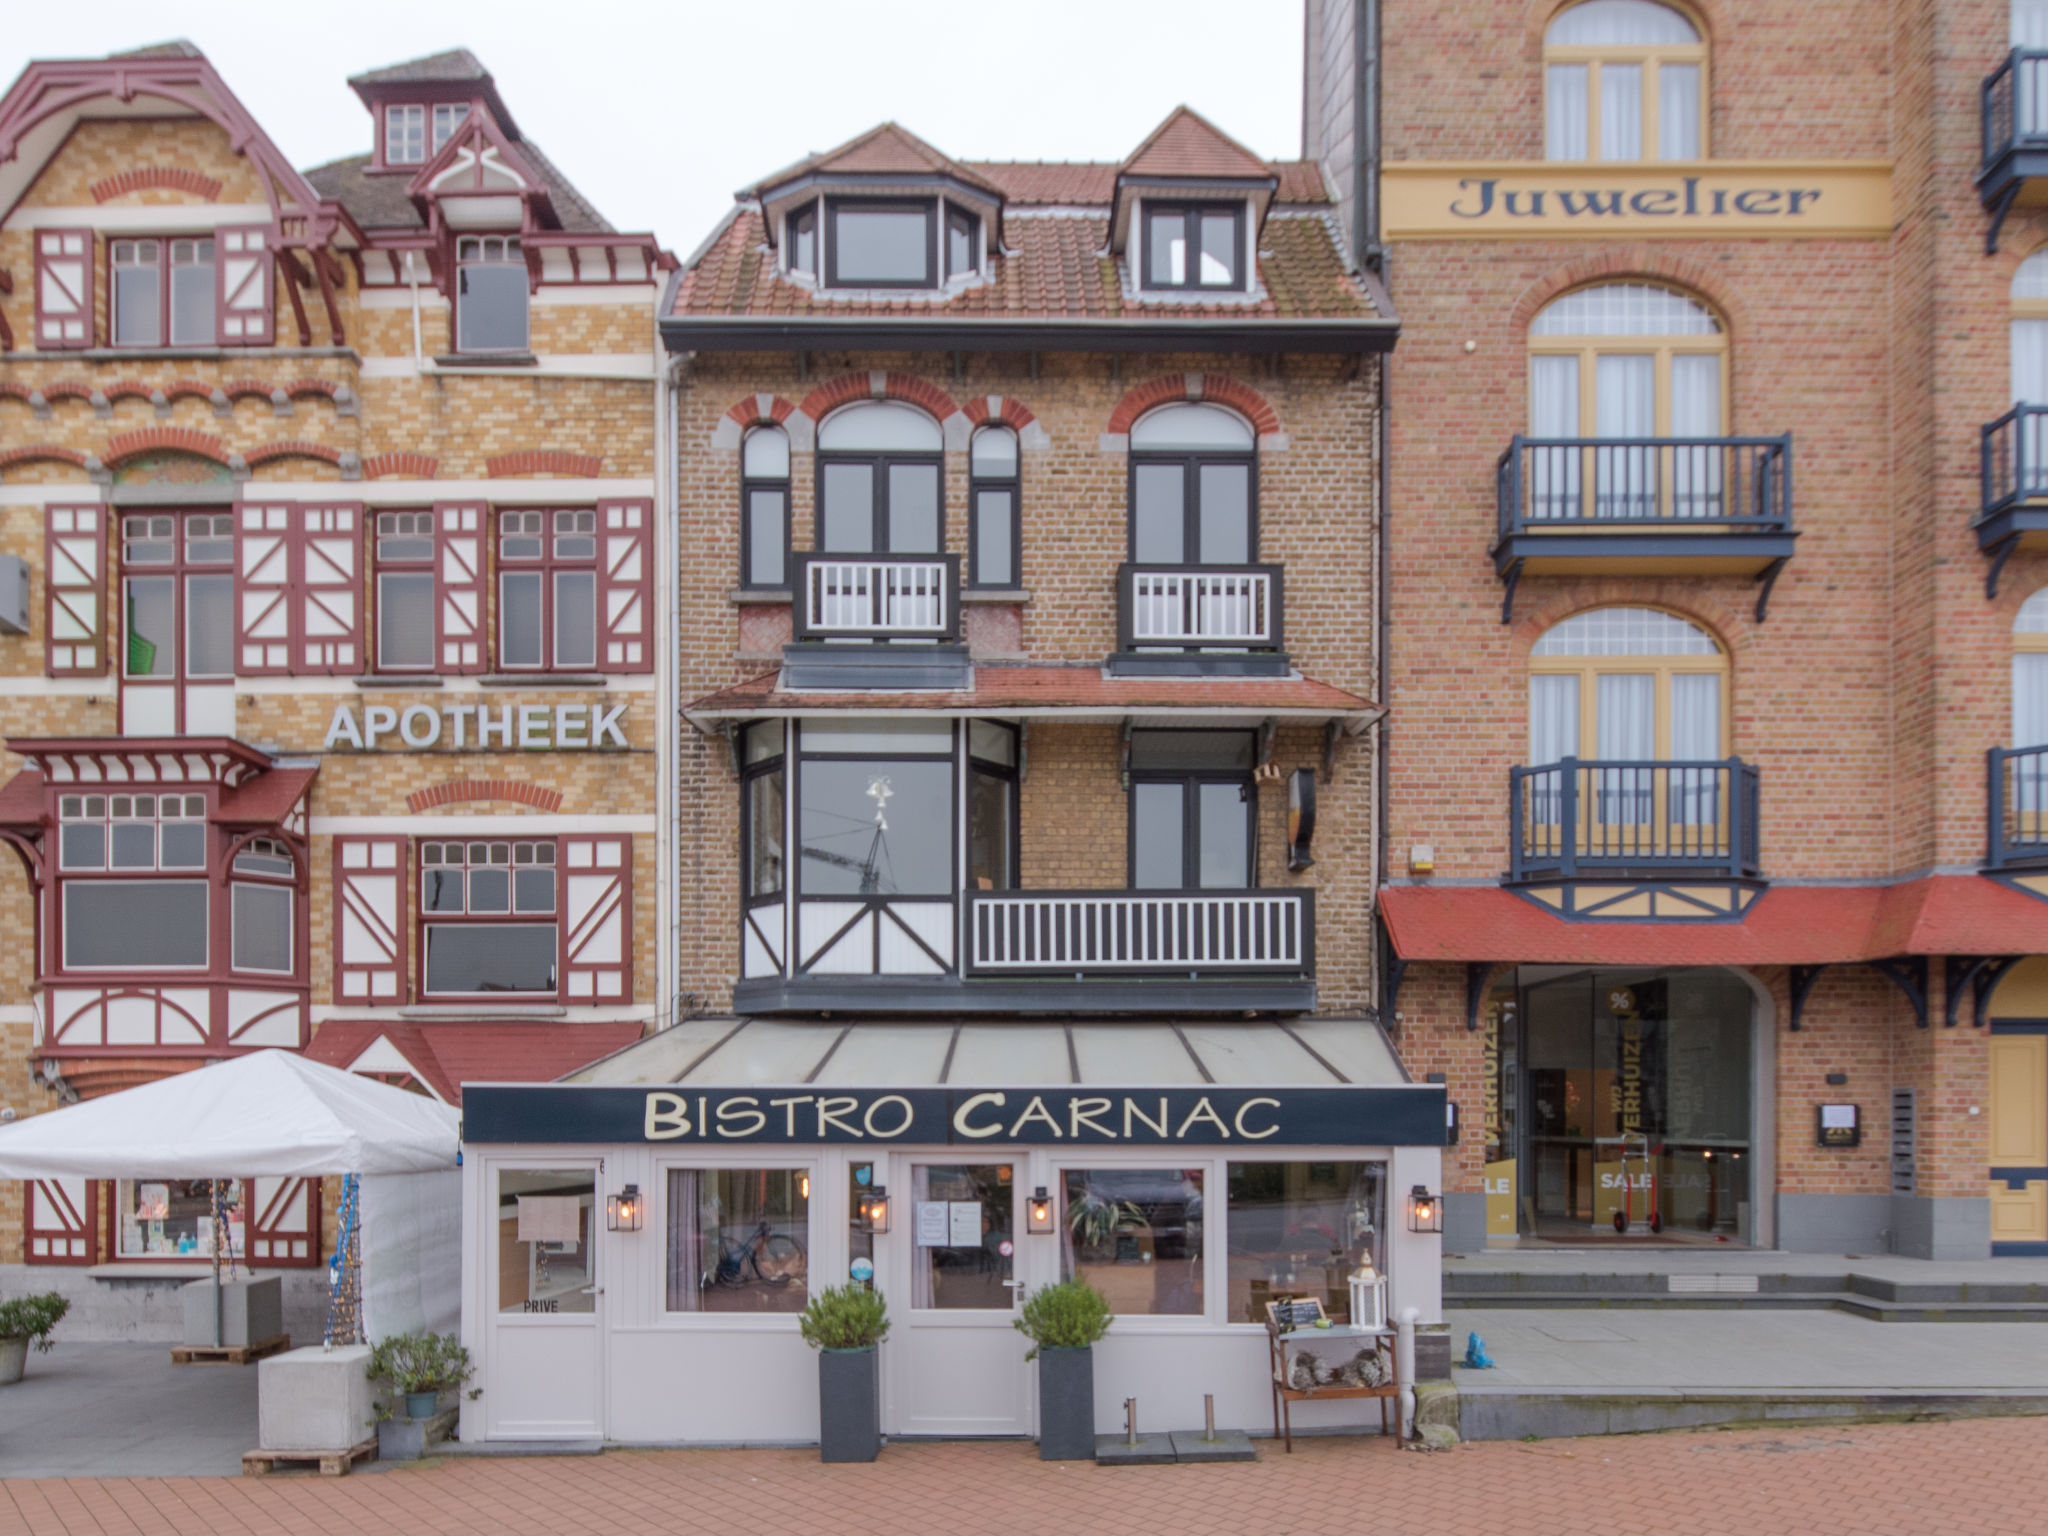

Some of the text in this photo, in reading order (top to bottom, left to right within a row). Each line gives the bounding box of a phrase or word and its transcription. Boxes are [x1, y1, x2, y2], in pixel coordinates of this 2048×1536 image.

[1449, 176, 1821, 217] Juwelier
[324, 704, 628, 748] APOTHEEK
[1623, 1009, 1641, 1144] VERHUIZEN
[644, 1092, 1281, 1139] BISTRO CARNAC
[1601, 1172, 1653, 1189] SALE
[523, 1299, 559, 1313] PRIVE
